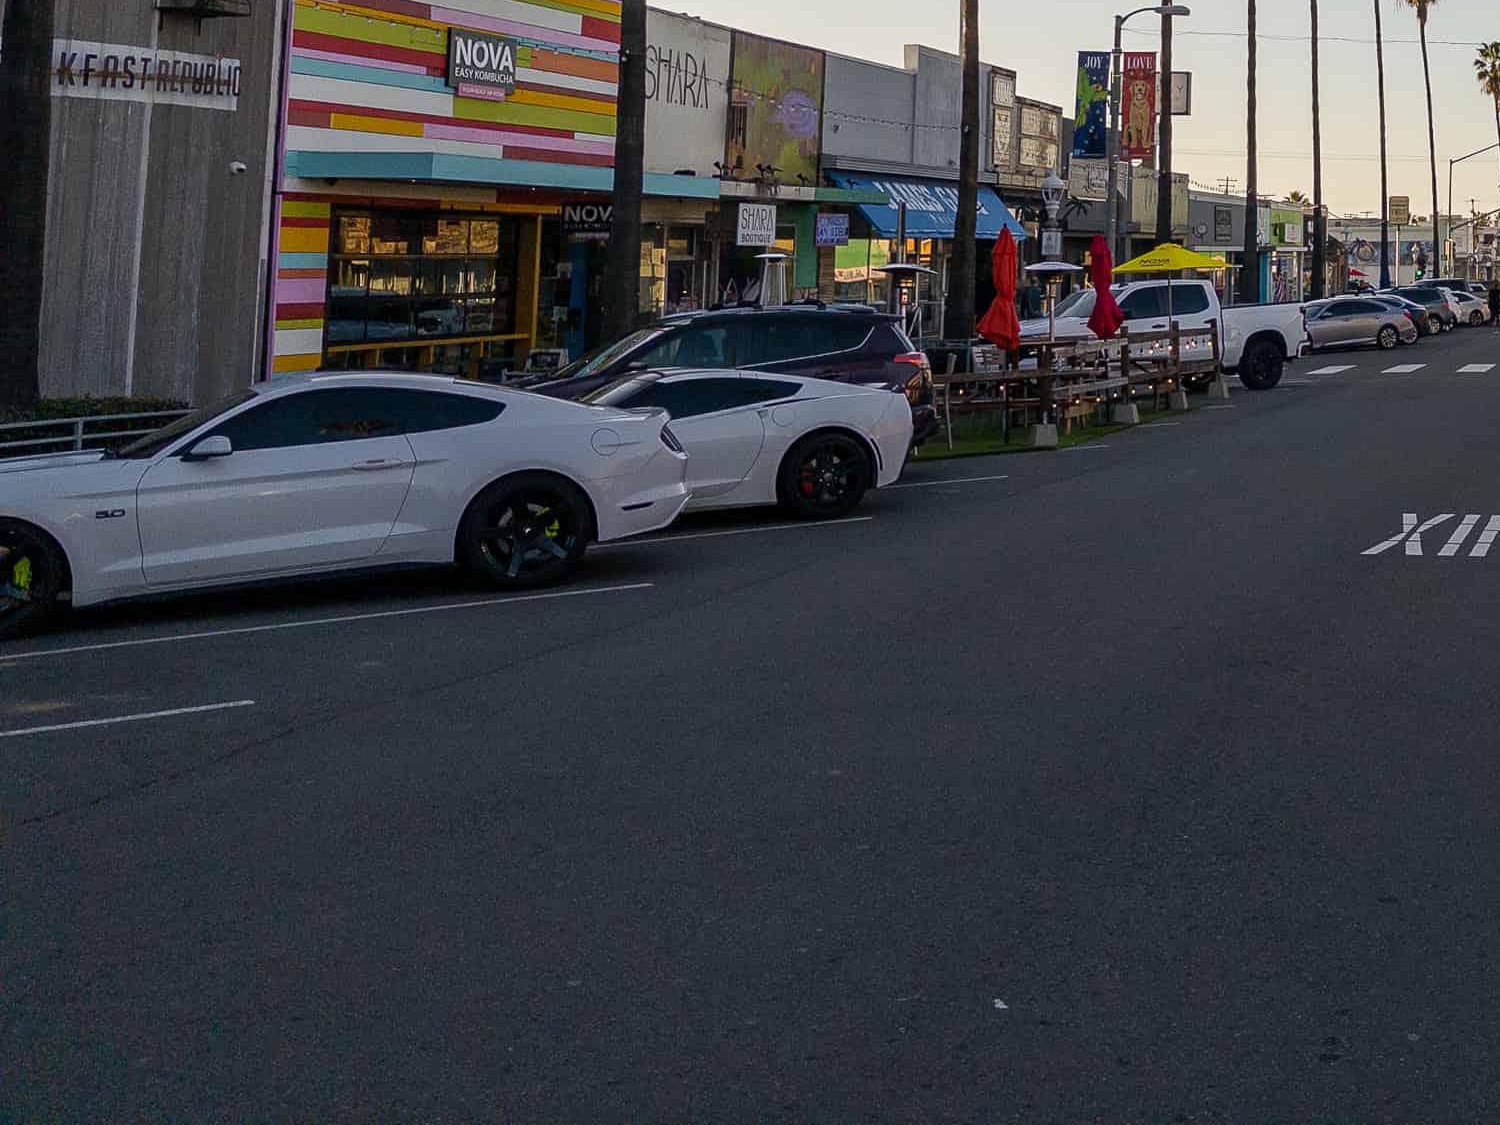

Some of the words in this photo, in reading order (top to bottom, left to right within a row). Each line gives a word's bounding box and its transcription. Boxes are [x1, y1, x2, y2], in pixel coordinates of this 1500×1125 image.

[455, 36, 514, 73] NOVA
[1084, 56, 1104, 69] JOY
[1127, 57, 1153, 69] LOVE
[156, 59, 241, 97] REPUBLIC
[455, 66, 474, 79] EASY
[475, 70, 514, 85] KOMBUCHA
[644, 44, 709, 109] SHARA
[564, 205, 613, 223] NOV
[741, 208, 775, 230] SHARA
[741, 234, 772, 245] BOUTIQUE
